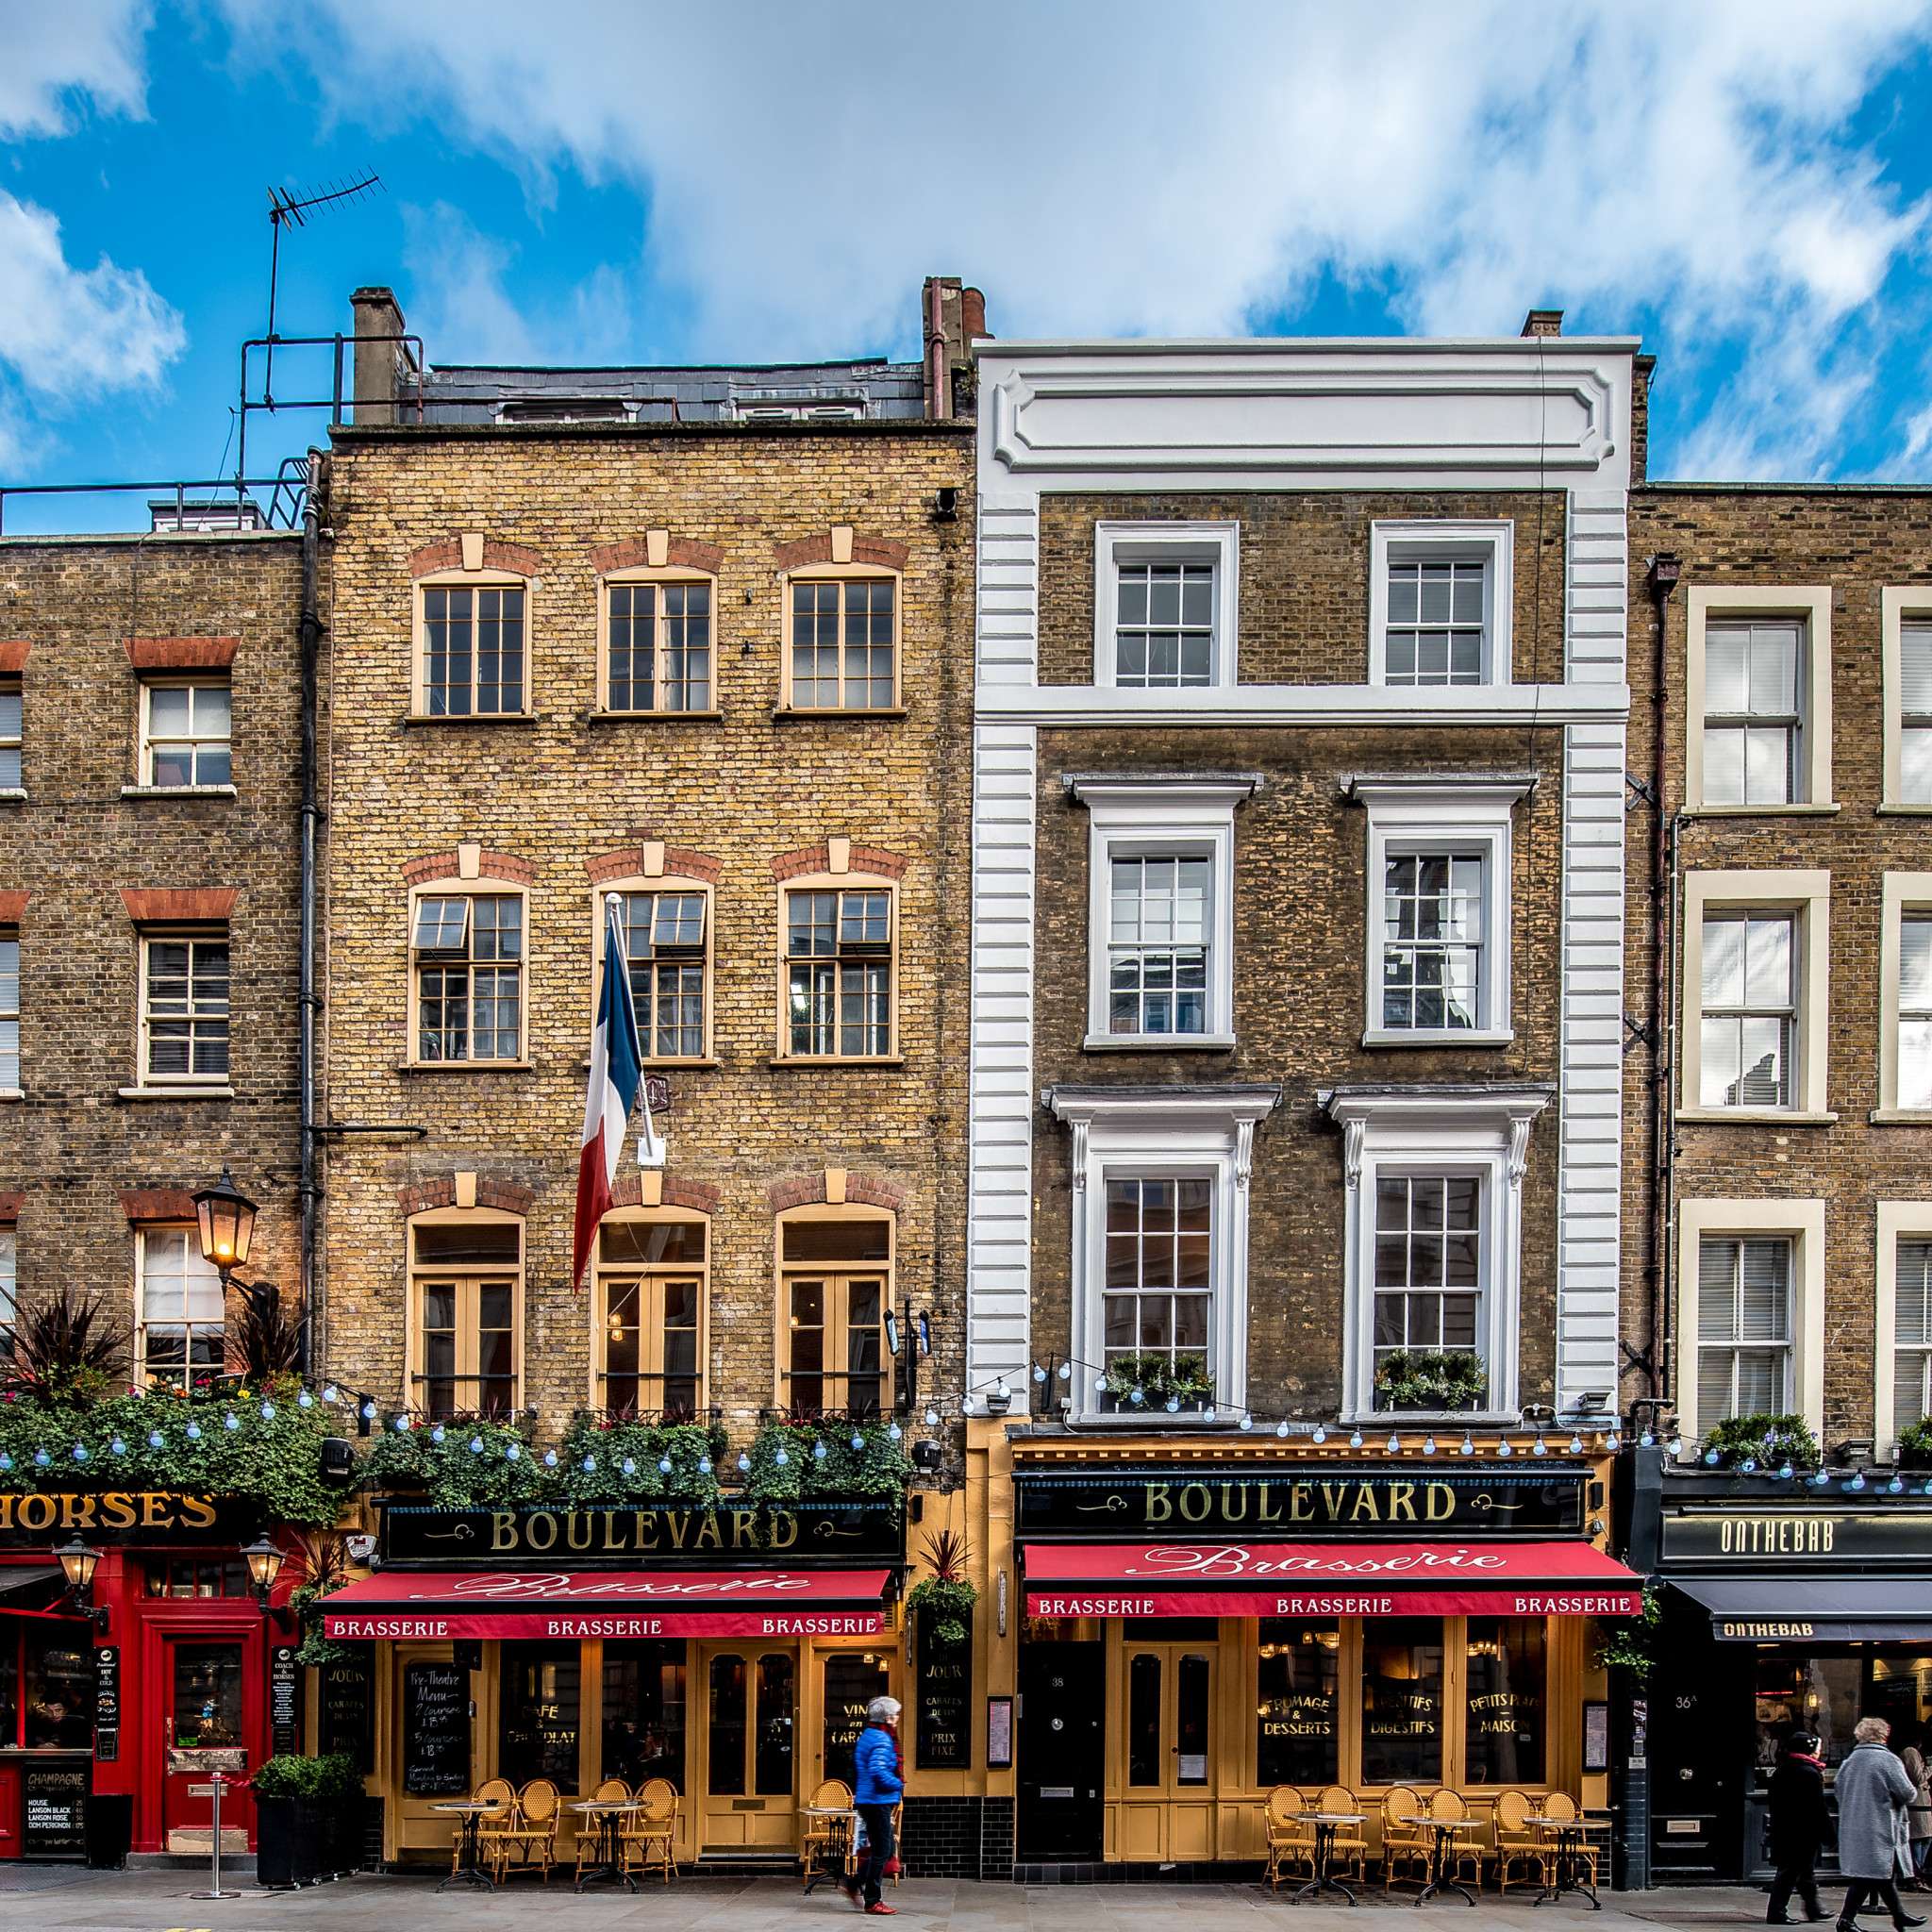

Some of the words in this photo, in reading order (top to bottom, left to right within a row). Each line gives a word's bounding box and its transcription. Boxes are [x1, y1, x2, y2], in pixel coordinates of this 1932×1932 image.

[1143, 1483, 1457, 1522] BOULEVARD
[491, 1510, 798, 1550] BOULEVARD
[1124, 1544, 1507, 1575] Brasserie
[408, 1572, 811, 1598] Brasserie
[1039, 1599, 1155, 1614] BRASSERIE
[1276, 1598, 1392, 1613] BRASSERIE
[1514, 1597, 1631, 1612] BRASSERIE
[333, 1621, 448, 1636] BRASSERIE
[548, 1620, 662, 1635] BRASSERIE
[762, 1618, 876, 1633] BRASSERIE
[1469, 1692, 1508, 1712] PETITS
[1292, 1710, 1301, 1720] &
[1264, 1722, 1331, 1735] DESSERTS
[1371, 1721, 1435, 1734] DIGESTIFS
[28, 1773, 85, 1786] CHAMPAGNE
